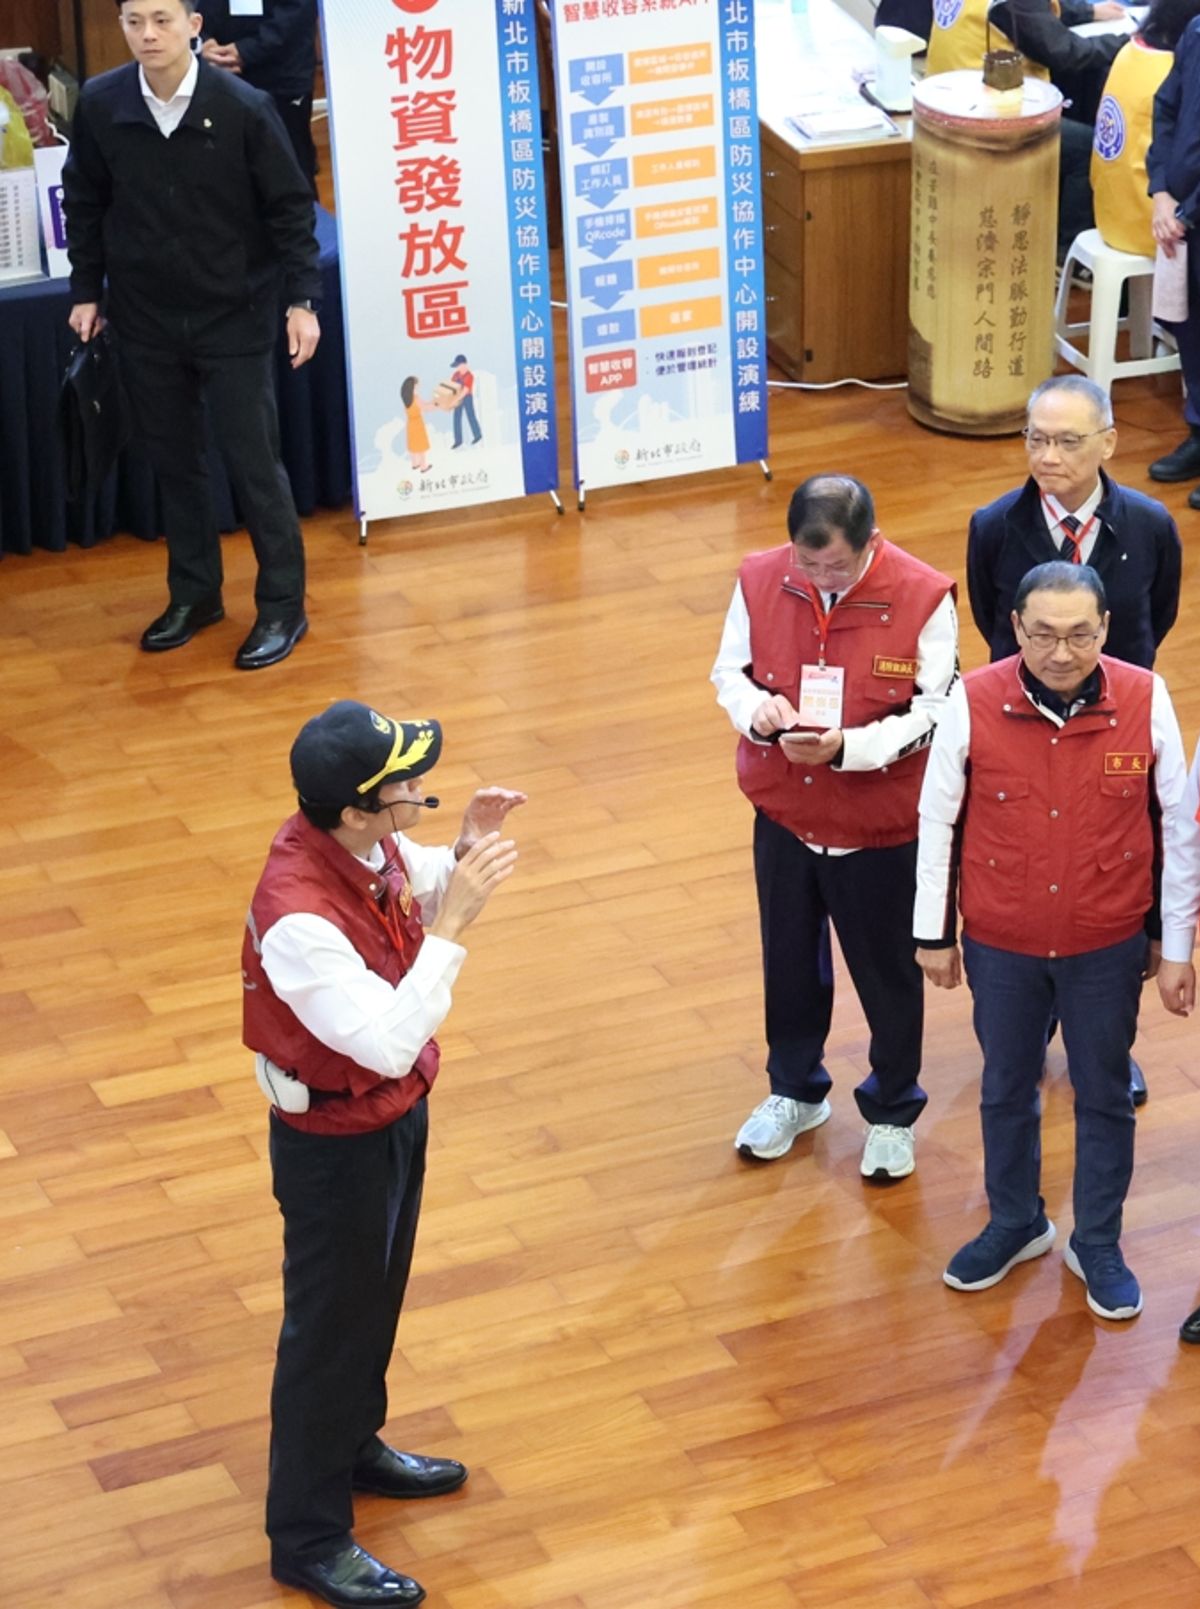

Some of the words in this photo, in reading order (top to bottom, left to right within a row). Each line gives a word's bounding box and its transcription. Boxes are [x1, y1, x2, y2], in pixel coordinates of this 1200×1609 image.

[384, 25, 472, 340] 物資發放區
[581, 175, 622, 191] 工作人員
[502, 0, 549, 442] 新北市板橋區防災協作中心開設演練
[585, 227, 626, 243] QRcode
[972, 205, 999, 379] 慈濟宗門人間路
[600, 373, 623, 386] APP
[635, 438, 701, 462] 新北市政府
[418, 469, 488, 492] 新北市政府
[1112, 756, 1141, 770] 市長
